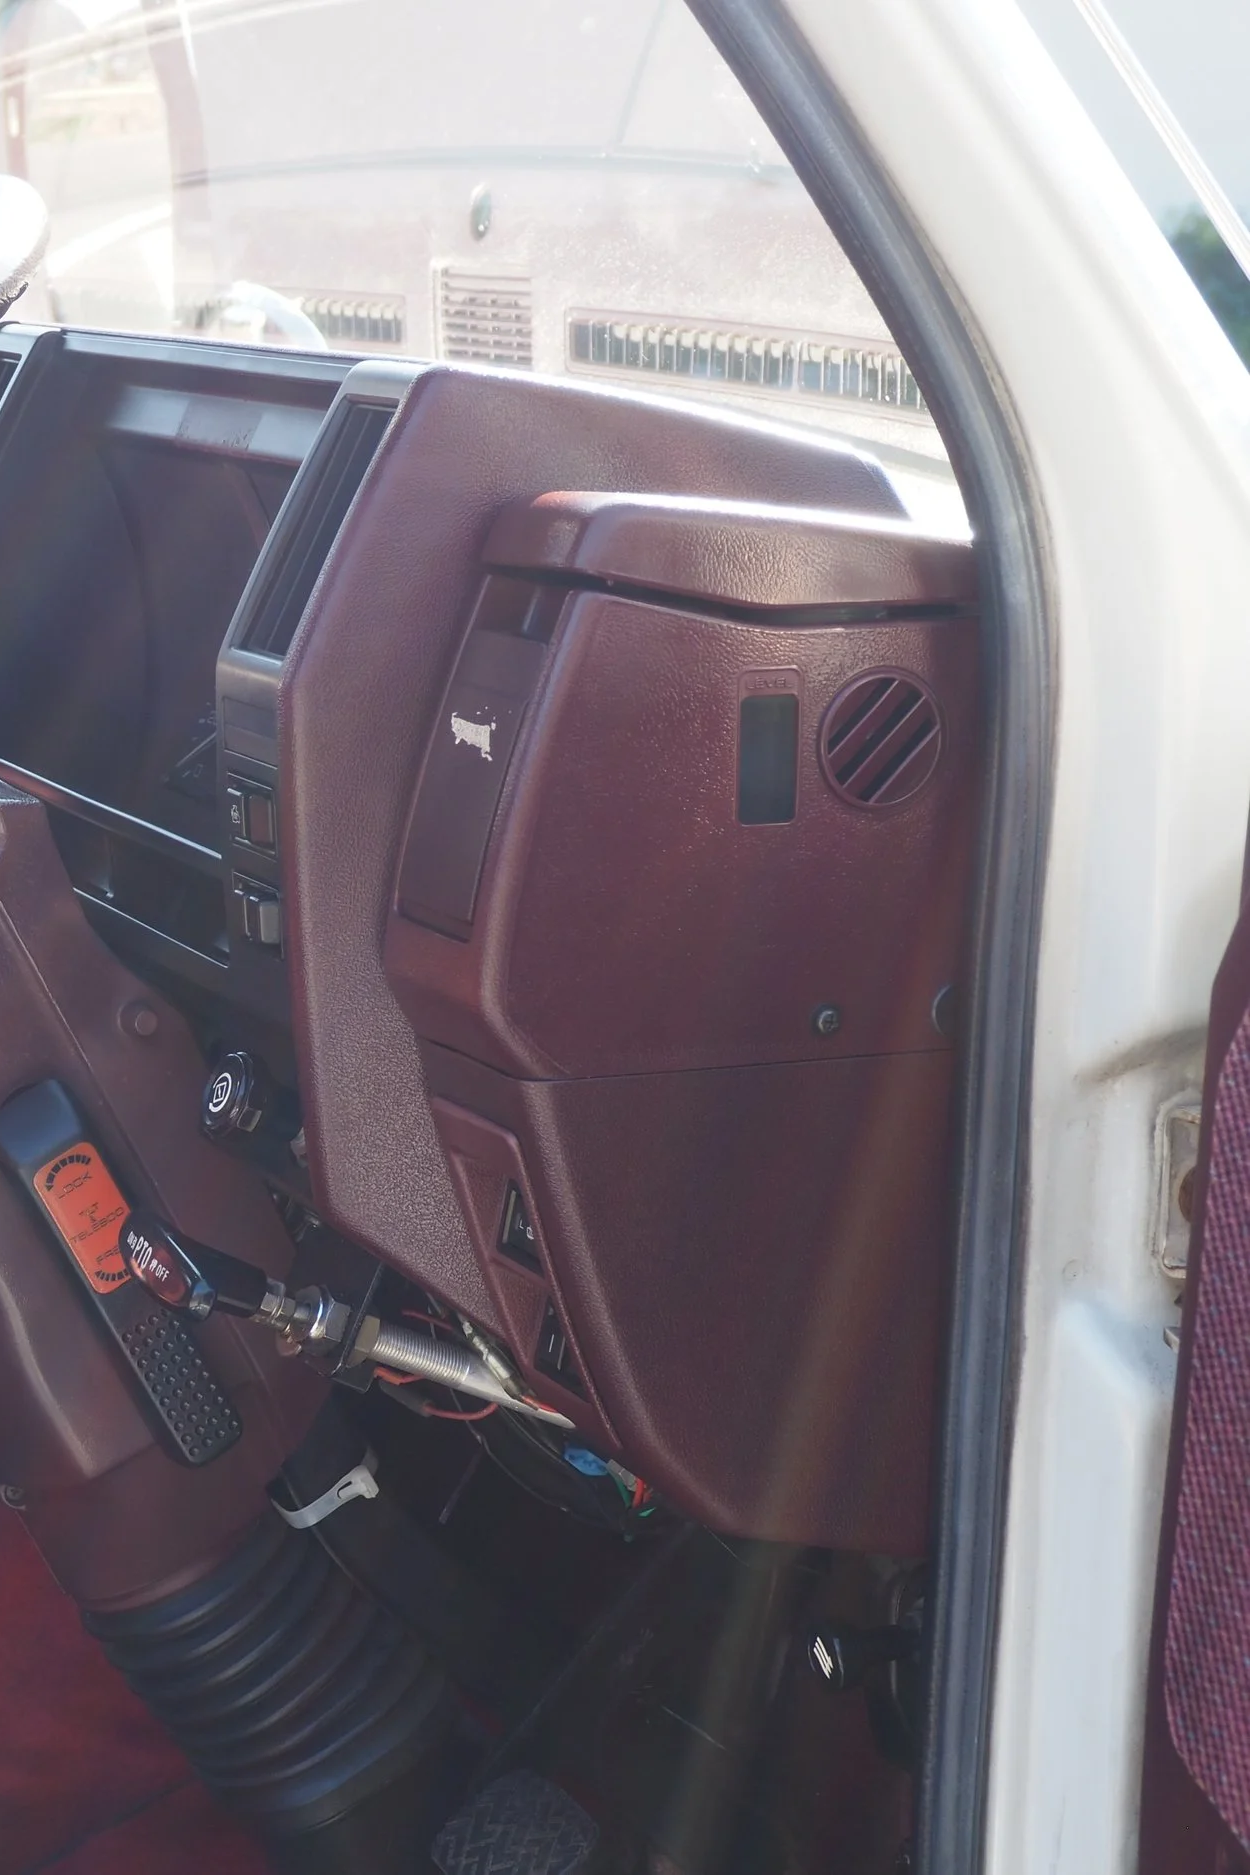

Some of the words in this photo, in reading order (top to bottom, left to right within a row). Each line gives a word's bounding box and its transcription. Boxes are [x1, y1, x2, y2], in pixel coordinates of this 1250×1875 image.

[746, 676, 794, 690] LEVEL
[57, 1171, 93, 1199] LOCK
[132, 1235, 153, 1269] PTO
[155, 1264, 170, 1282] OFF
